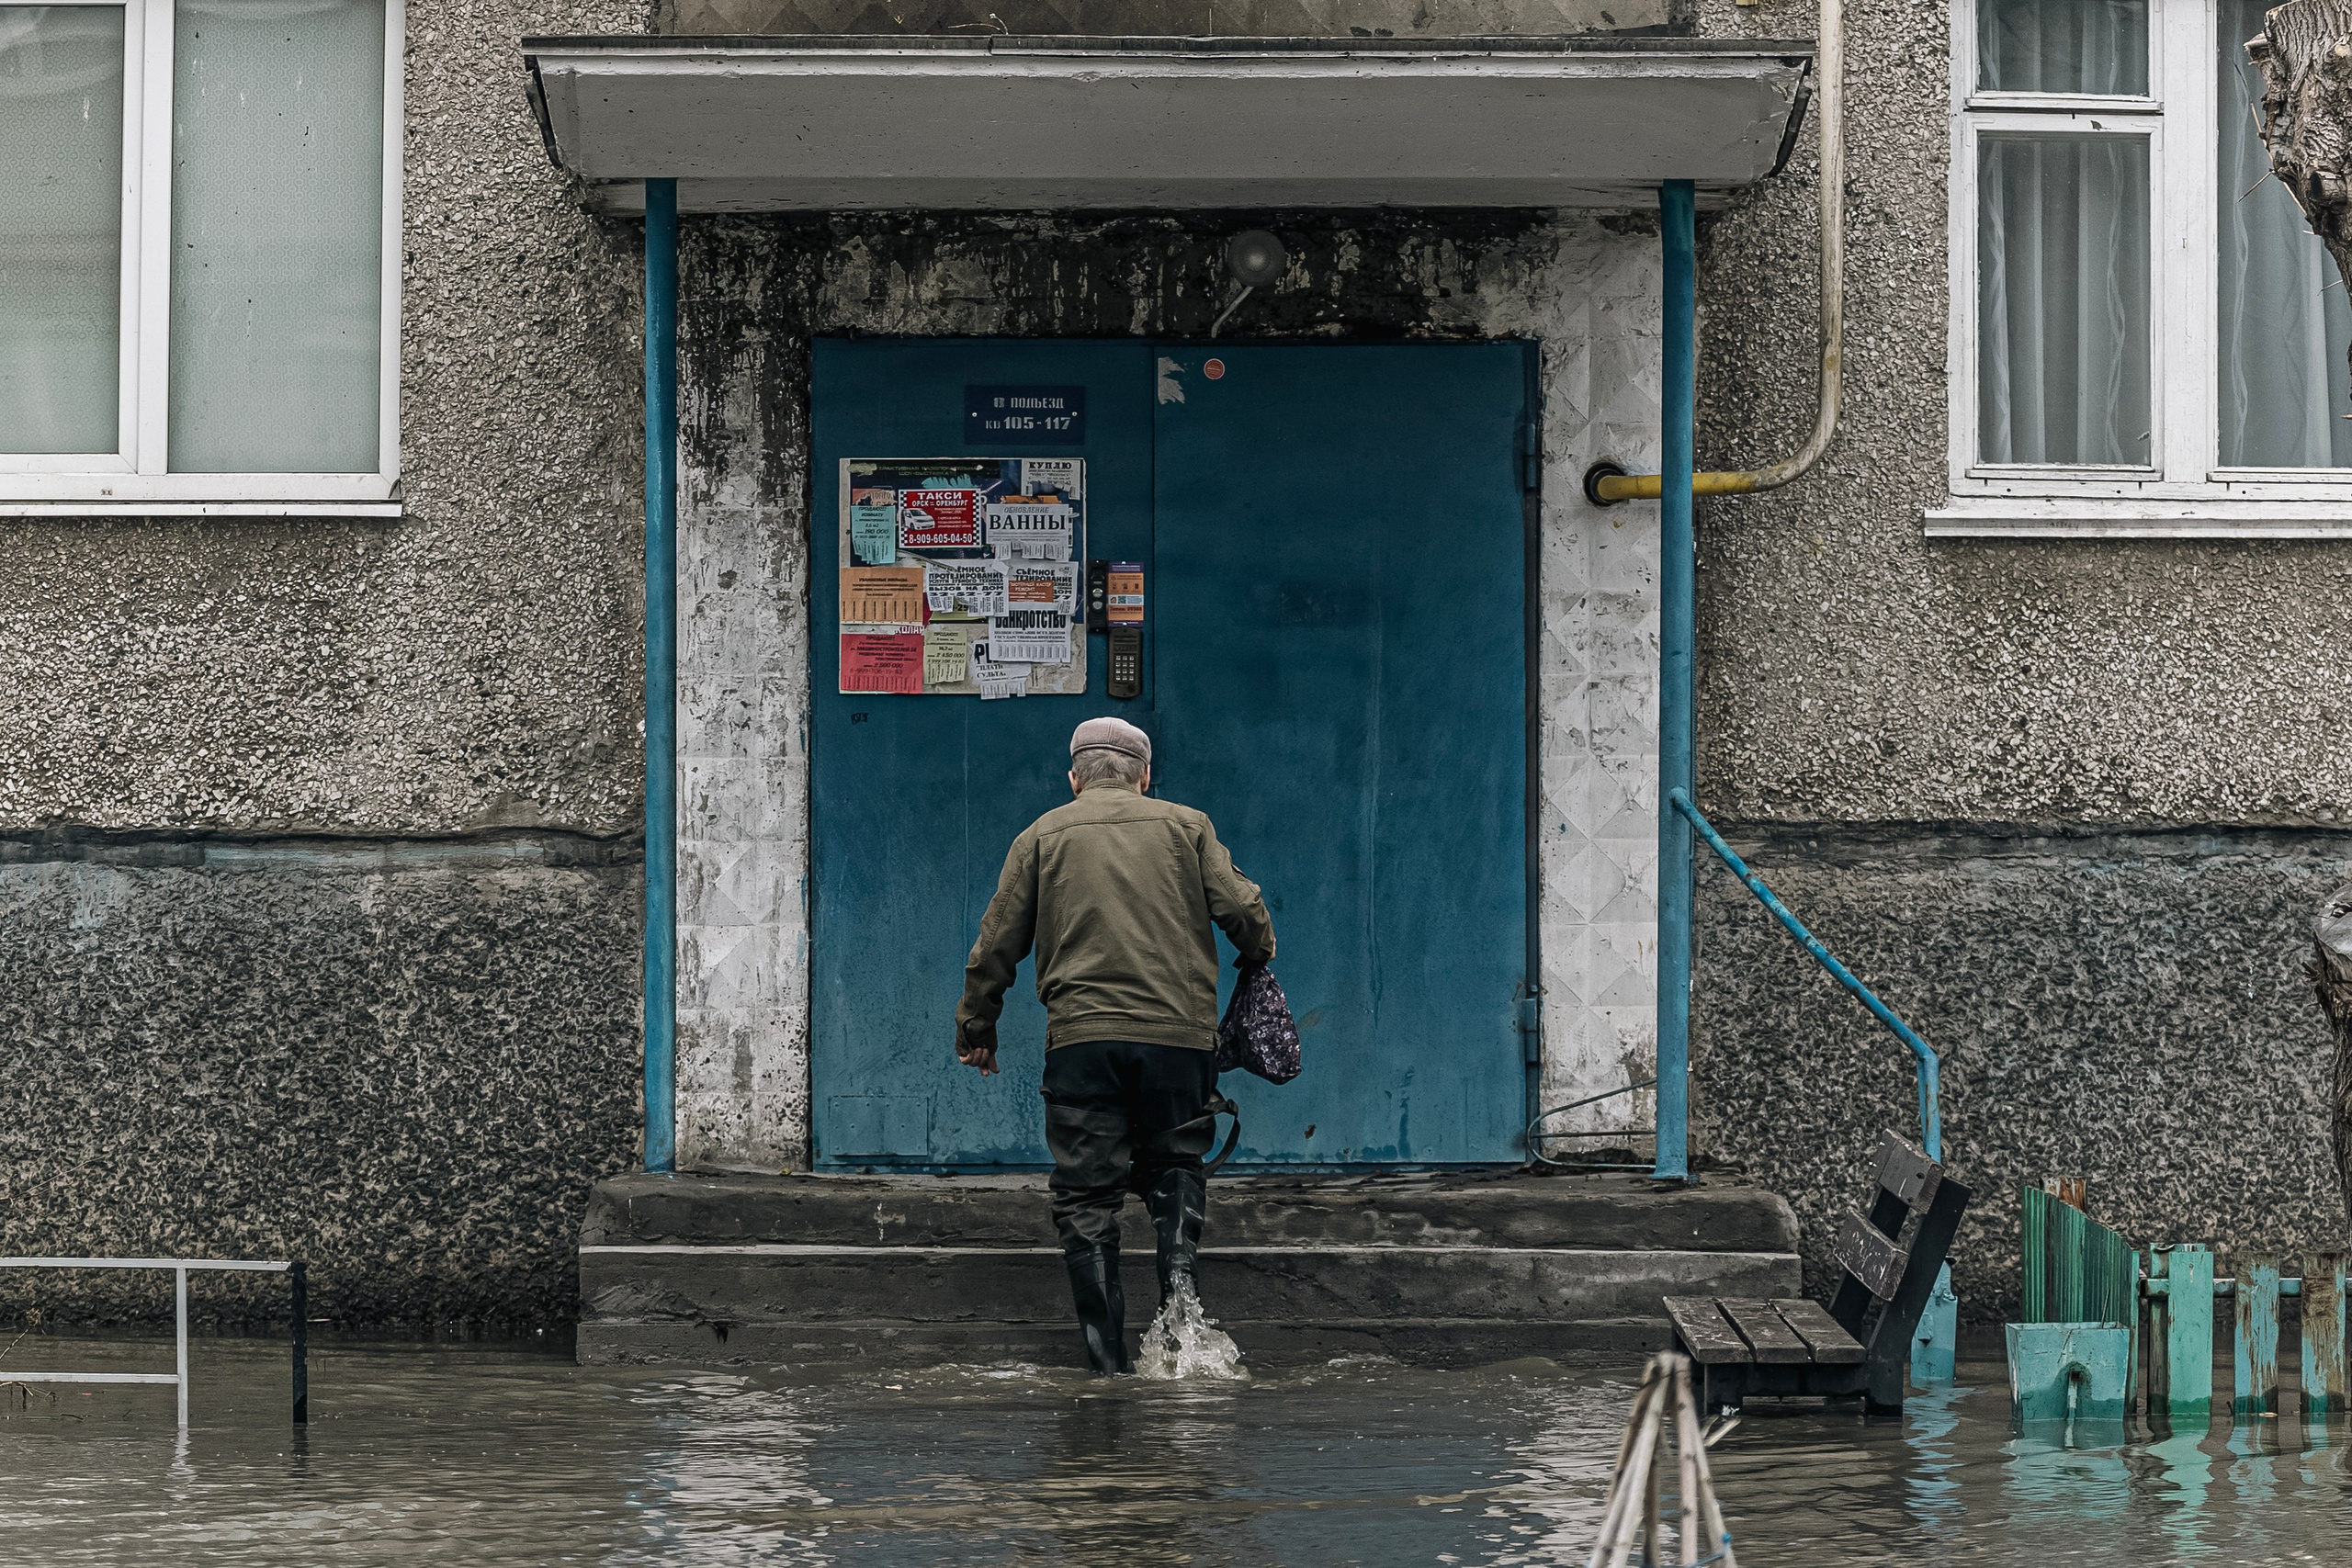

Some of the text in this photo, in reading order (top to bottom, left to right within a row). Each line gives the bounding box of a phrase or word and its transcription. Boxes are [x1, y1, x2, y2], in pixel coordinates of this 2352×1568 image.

[993, 397, 1005, 408] В
[1003, 416, 1070, 430] 105-117
[1028, 461, 1072, 469] КУПЛЮ
[917, 491, 963, 500] ТАКСИ
[936, 499, 968, 507] ОРЕНБУРГ
[989, 514, 1066, 530] ВАННЫ
[909, 533, 973, 544] 8-909-605-04-50
[1015, 568, 1055, 576] СЪЁМНОЕ
